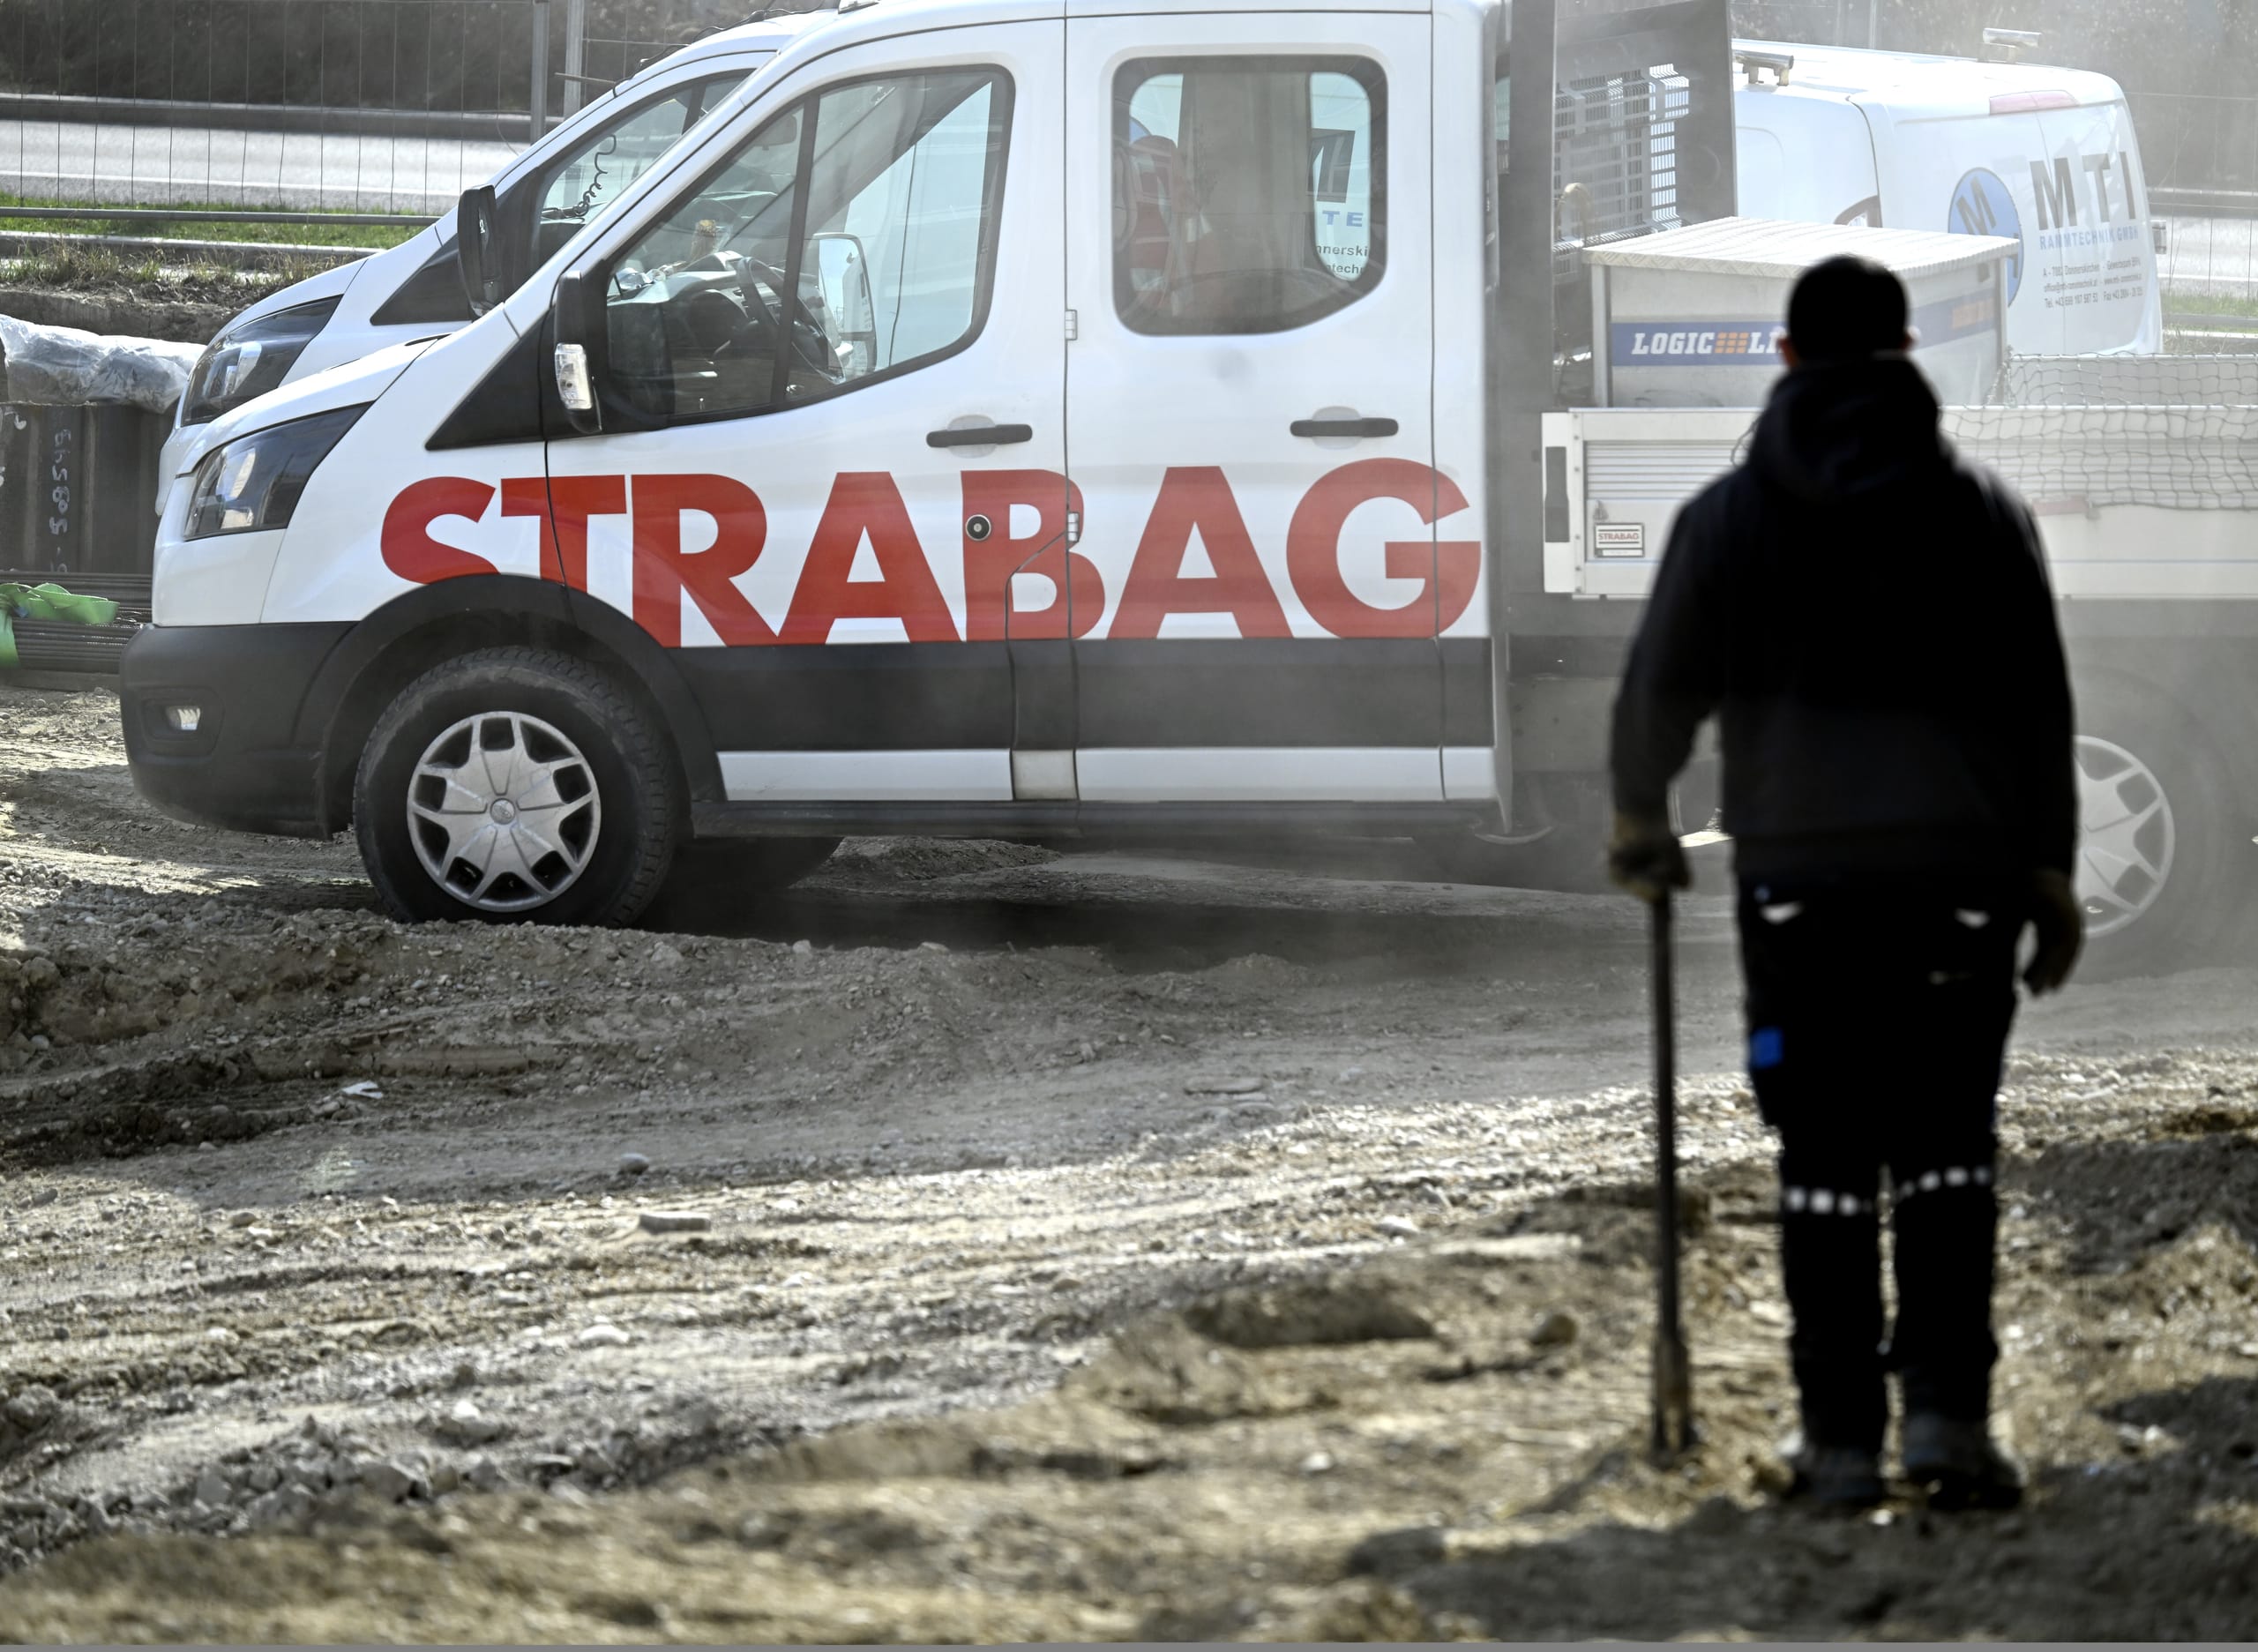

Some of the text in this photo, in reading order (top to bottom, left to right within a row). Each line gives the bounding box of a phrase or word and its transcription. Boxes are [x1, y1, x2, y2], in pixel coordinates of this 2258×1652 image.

[2030, 151, 2137, 230] MTI
[2039, 228, 2115, 250] RAMMTECHNIK
[1632, 332, 1716, 355] LOGIC
[379, 457, 1483, 648] STRABAG
